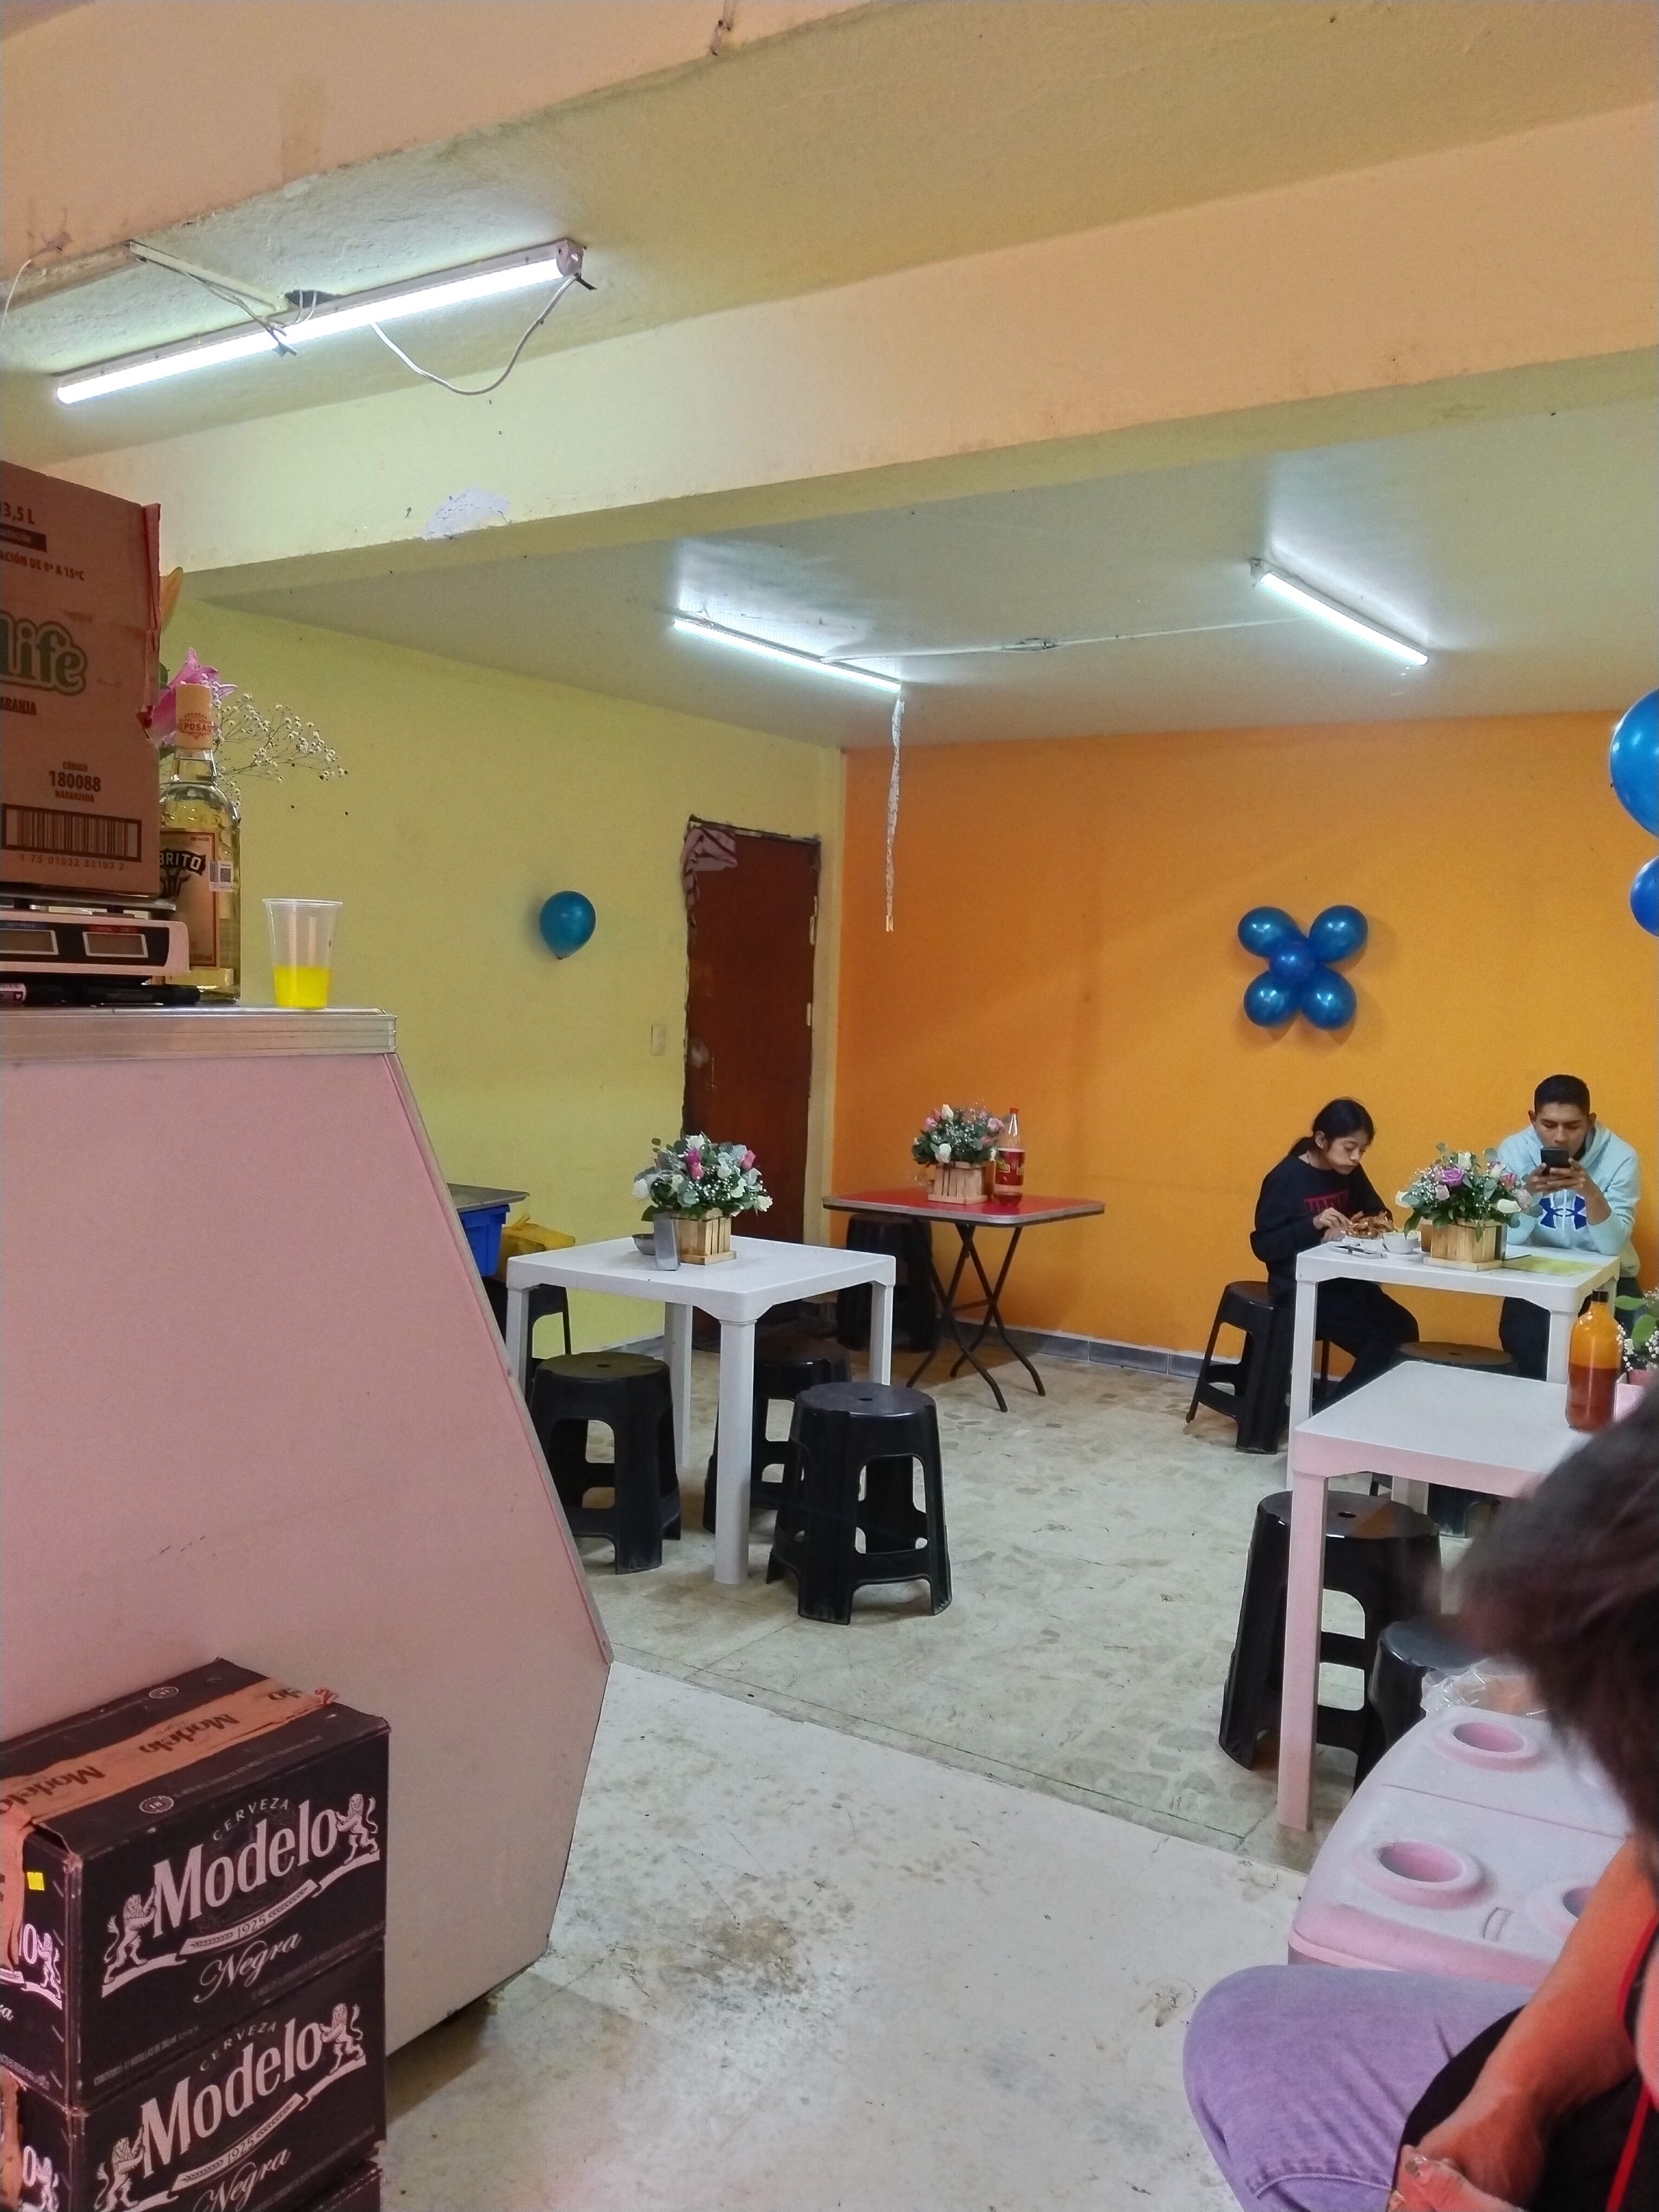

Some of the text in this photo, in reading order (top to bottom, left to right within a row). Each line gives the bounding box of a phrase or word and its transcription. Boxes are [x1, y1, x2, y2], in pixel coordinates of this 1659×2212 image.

[0, 502, 35, 525] 3,5 L
[29, 557, 42, 570] DE
[56, 565, 62, 576] A
[49, 770, 101, 793] 180088
[31, 854, 43, 863] 75
[48, 855, 80, 867] 01032
[118, 862, 125, 871] 2
[139, 1713, 240, 1753] Modelo
[213, 1797, 289, 1841] CERVEZA
[153, 1799, 338, 1939] Modelo
[237, 1914, 267, 1938] 1925
[193, 1933, 302, 2003] Negra
[199, 2021, 277, 2072] CERVEZA
[140, 2017, 323, 2179] Modelo
[228, 2136, 255, 2165] 1925
[192, 2147, 291, 2212] Negra
